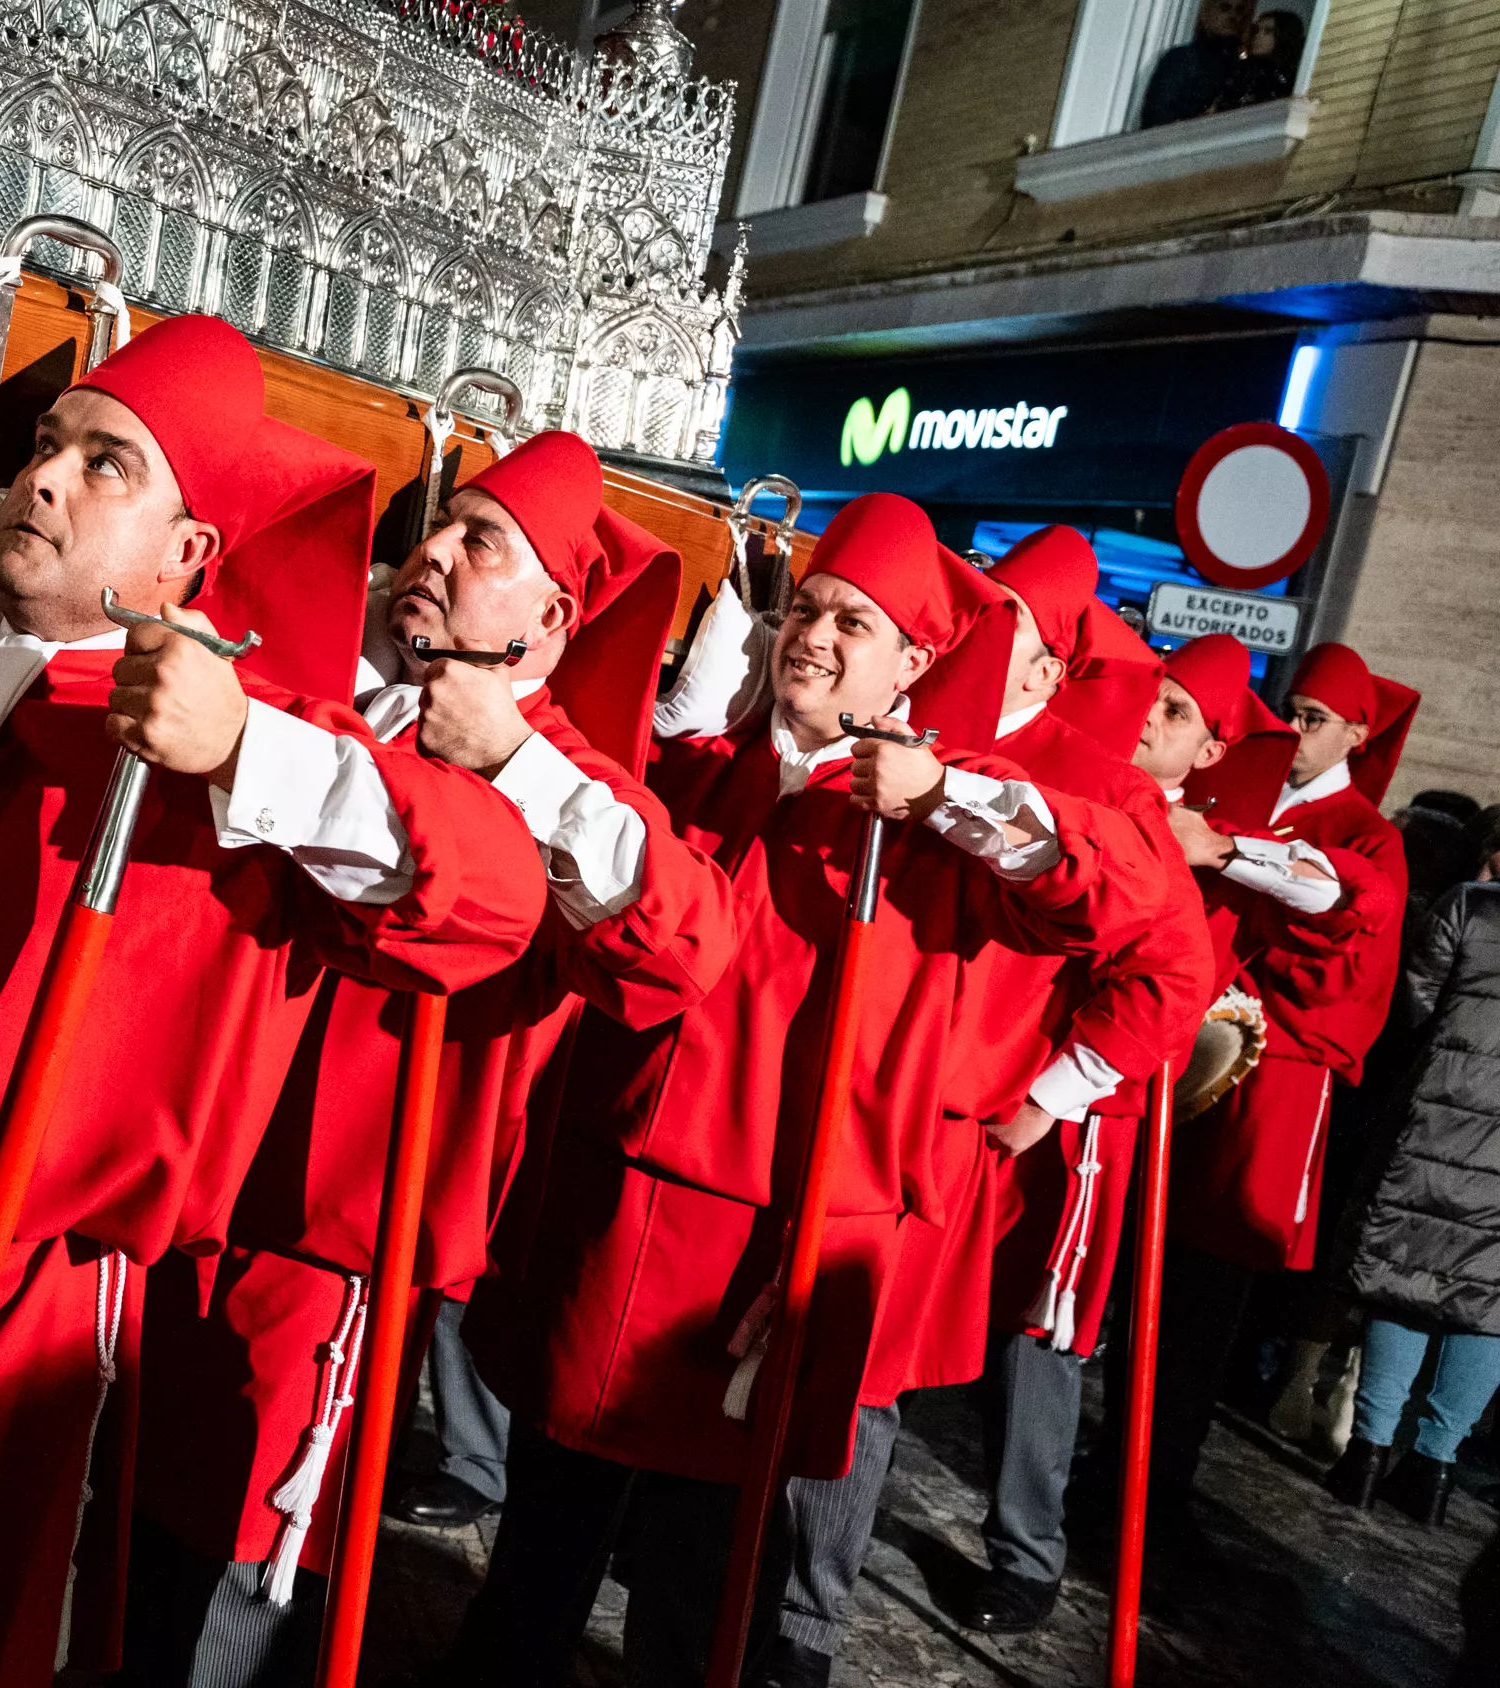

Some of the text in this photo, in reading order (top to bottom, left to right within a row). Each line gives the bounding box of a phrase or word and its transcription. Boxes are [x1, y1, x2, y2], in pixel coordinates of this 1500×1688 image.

[909, 400, 1068, 451] movistar
[1186, 594, 1269, 621] EXCEPTO
[1160, 611, 1286, 645] AUTORIZADOS
